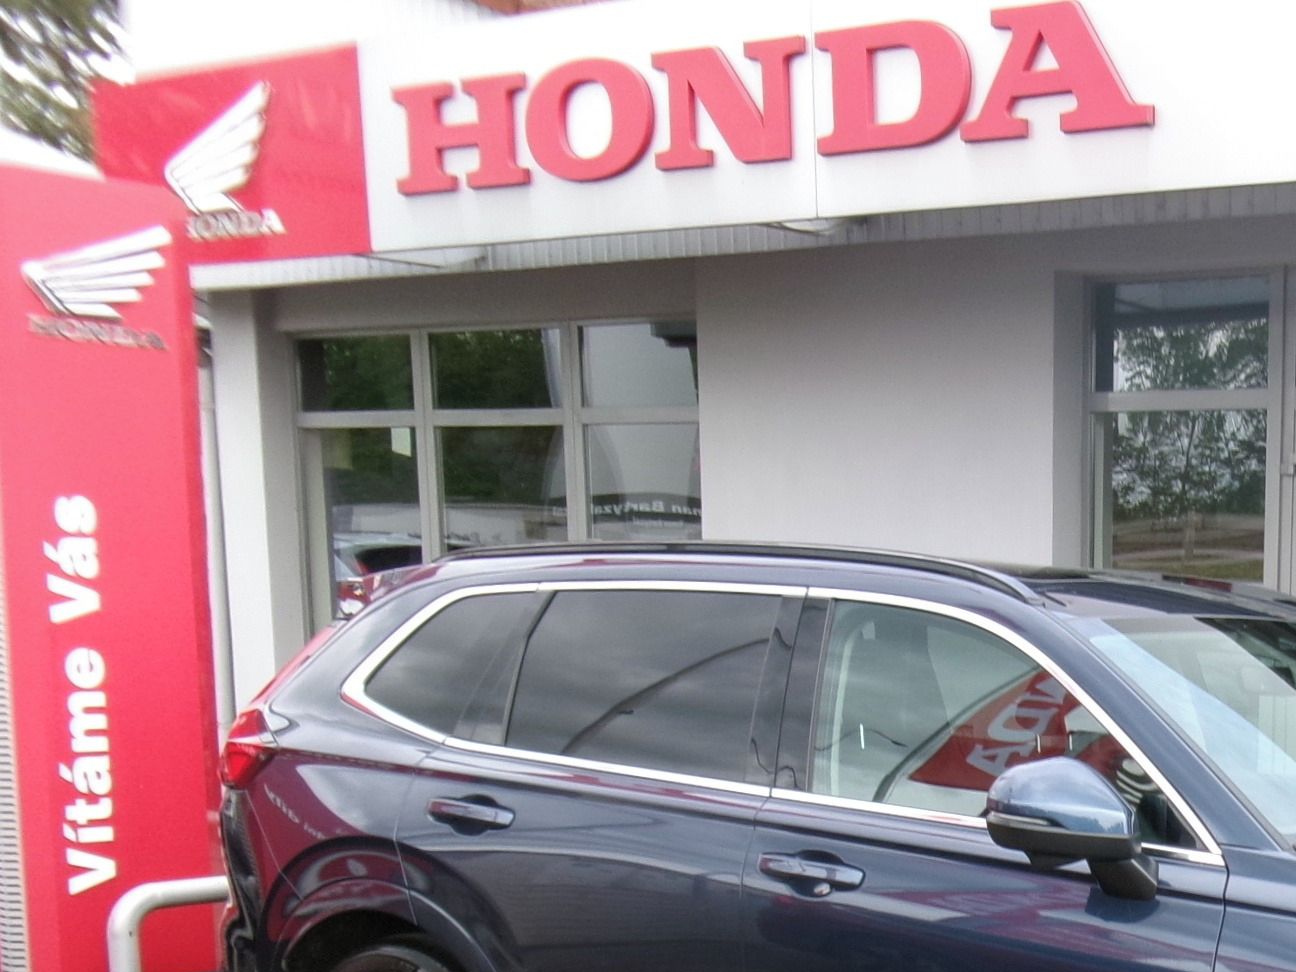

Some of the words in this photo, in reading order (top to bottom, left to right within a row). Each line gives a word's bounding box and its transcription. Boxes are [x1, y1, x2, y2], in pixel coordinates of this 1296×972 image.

[390, 0, 1155, 195] HONDA
[43, 494, 102, 624] Vás
[59, 646, 117, 896] Vítáme
